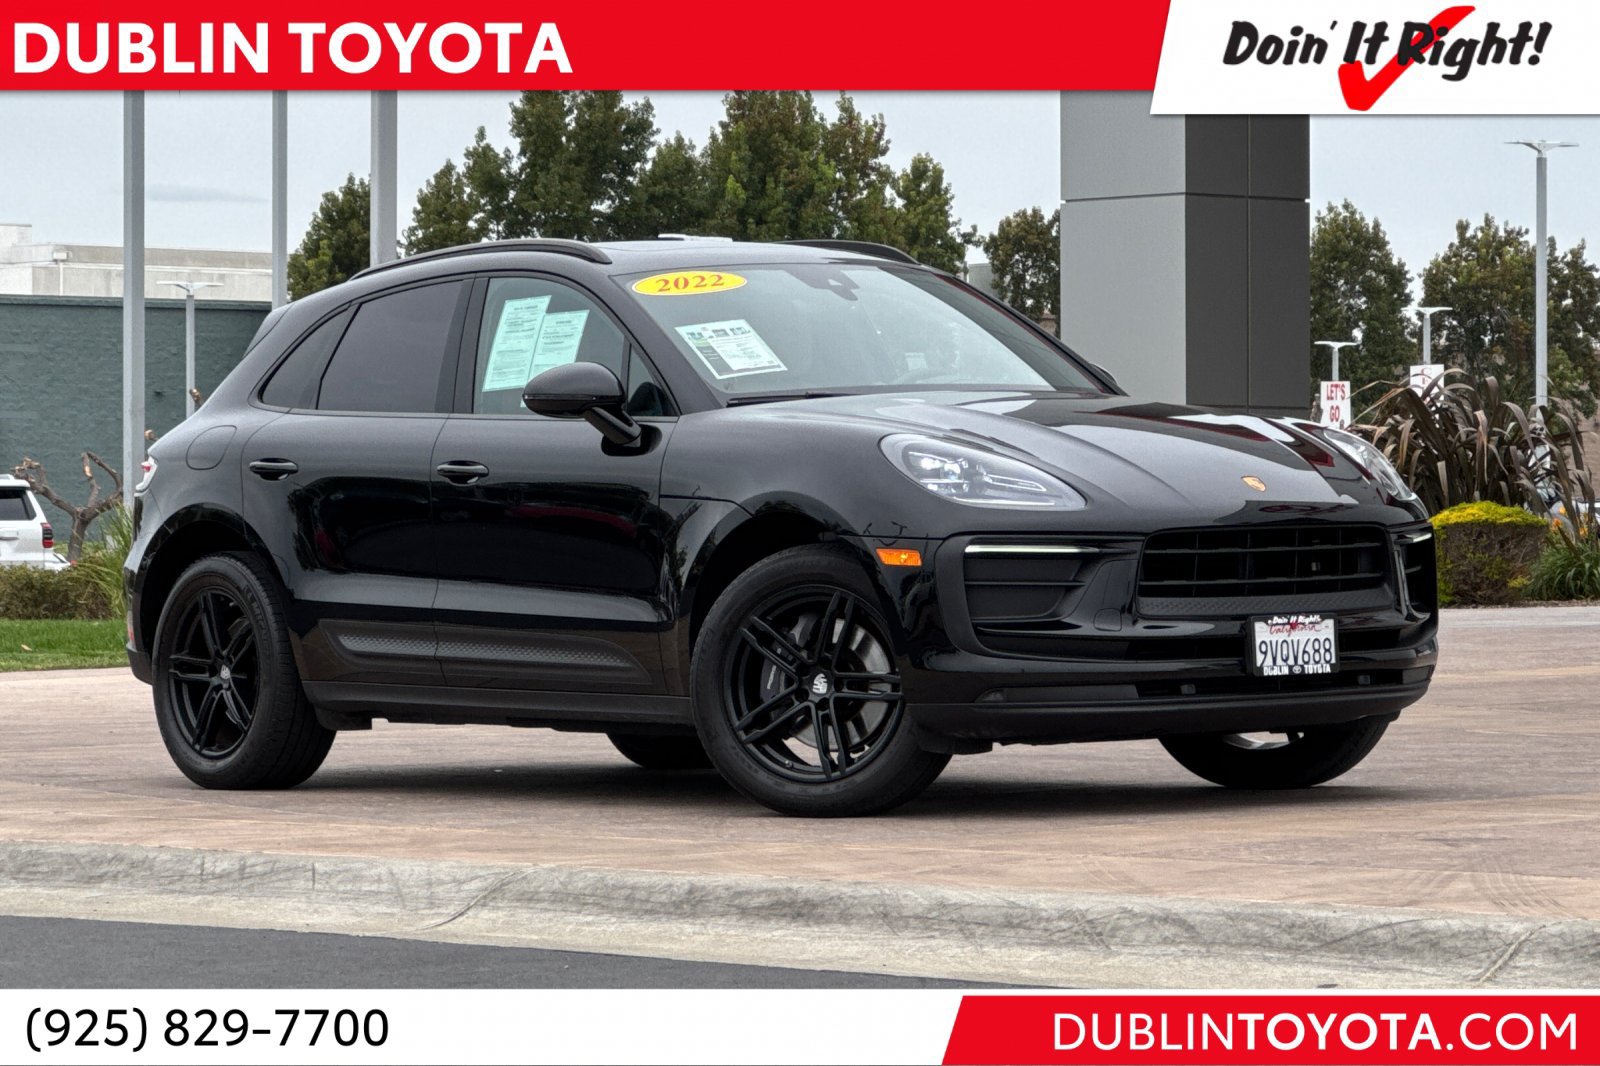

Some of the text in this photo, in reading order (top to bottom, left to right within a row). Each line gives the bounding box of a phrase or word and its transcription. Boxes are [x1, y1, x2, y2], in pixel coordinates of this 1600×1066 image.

[656, 275, 725, 293] 2022
[1326, 383, 1346, 401] LET'S
[1329, 405, 1340, 422] GO
[1258, 637, 1333, 667] 9VQV688
[1263, 663, 1331, 676] DUBLIN TOYOTA
